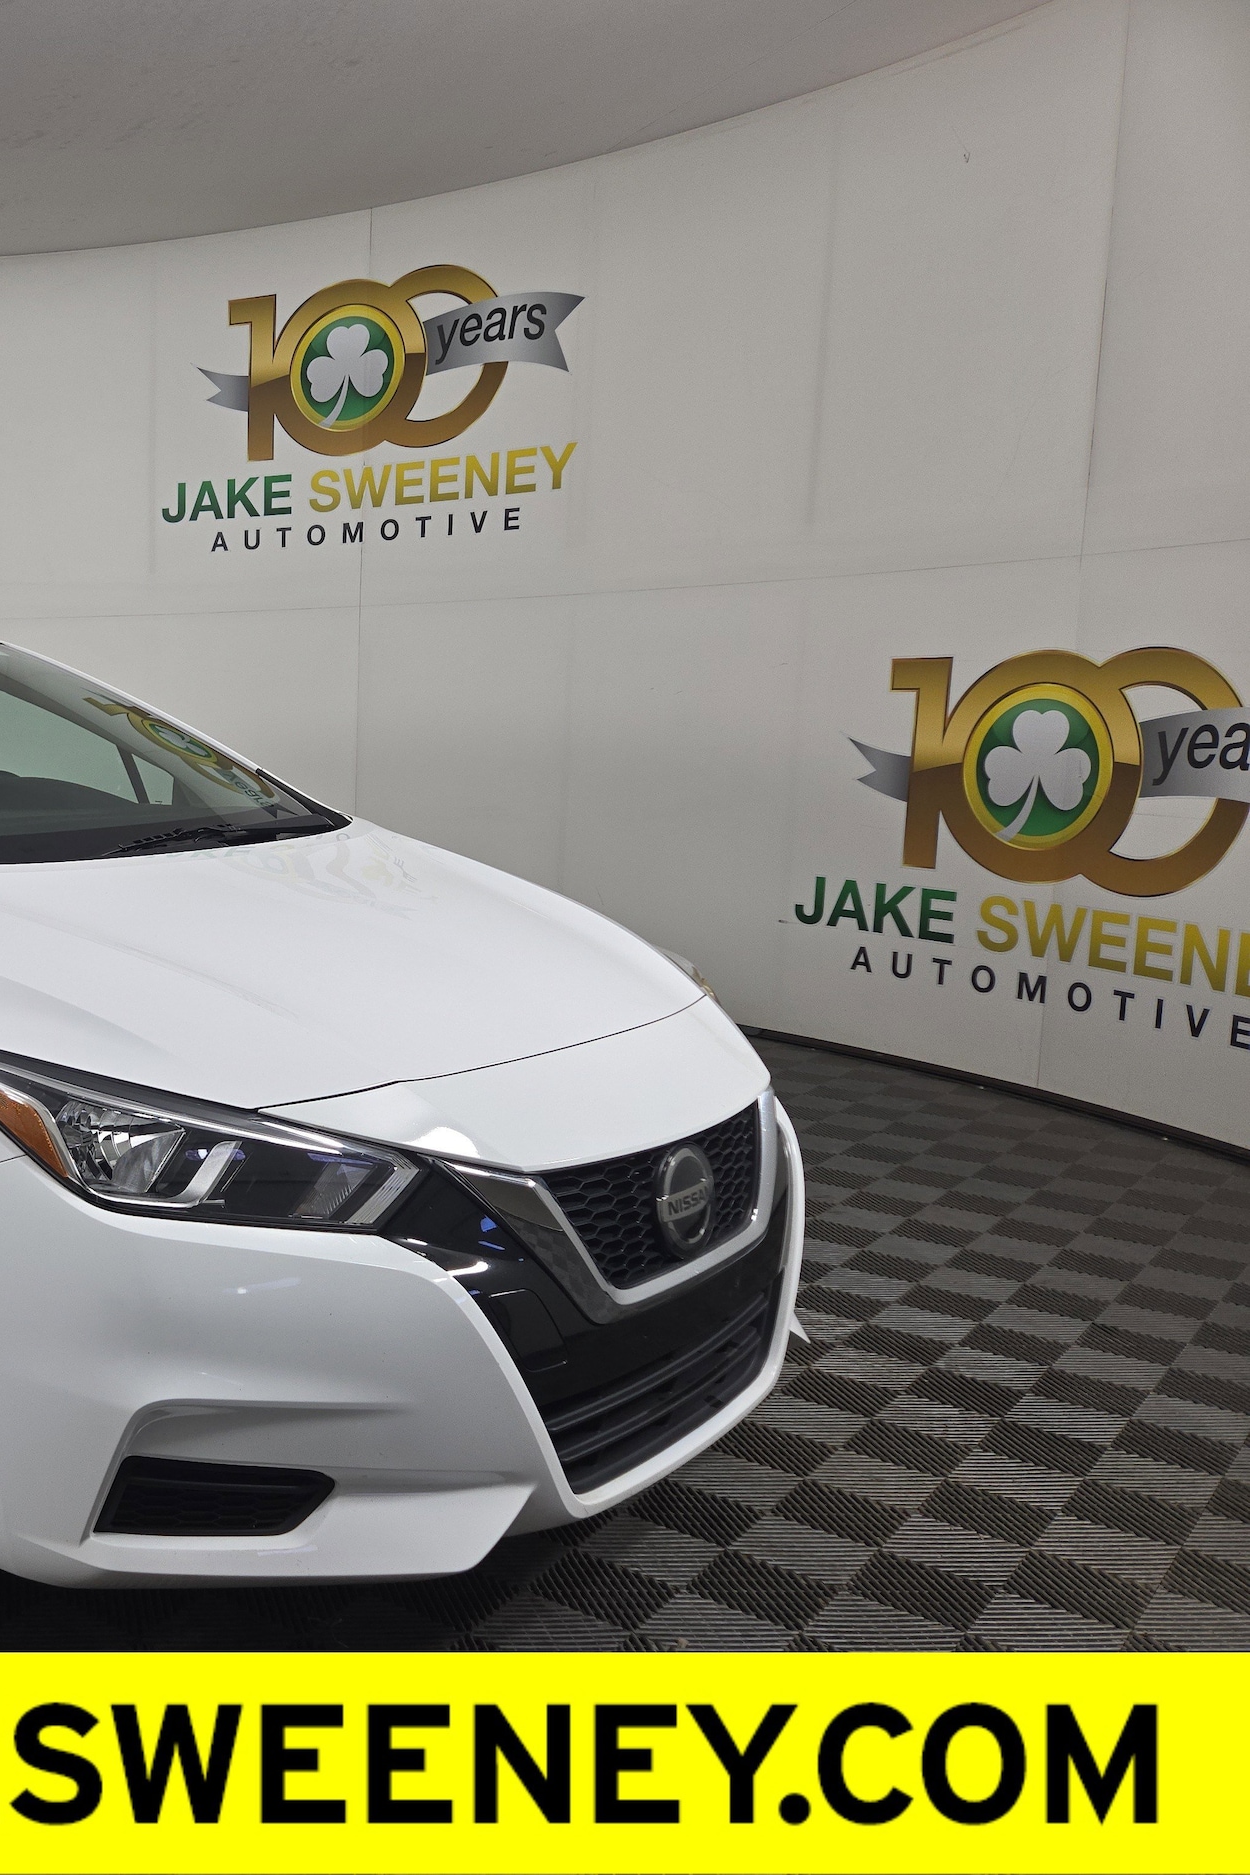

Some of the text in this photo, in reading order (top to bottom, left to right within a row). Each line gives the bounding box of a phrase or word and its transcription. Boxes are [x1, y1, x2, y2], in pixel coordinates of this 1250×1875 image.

[435, 302, 547, 365] years
[161, 442, 577, 523] JAKE SWEENEY
[211, 507, 521, 552] AUTOMOTIVE
[795, 876, 957, 944] JAKE
[850, 946, 1250, 1051] AUTOMOTIVE
